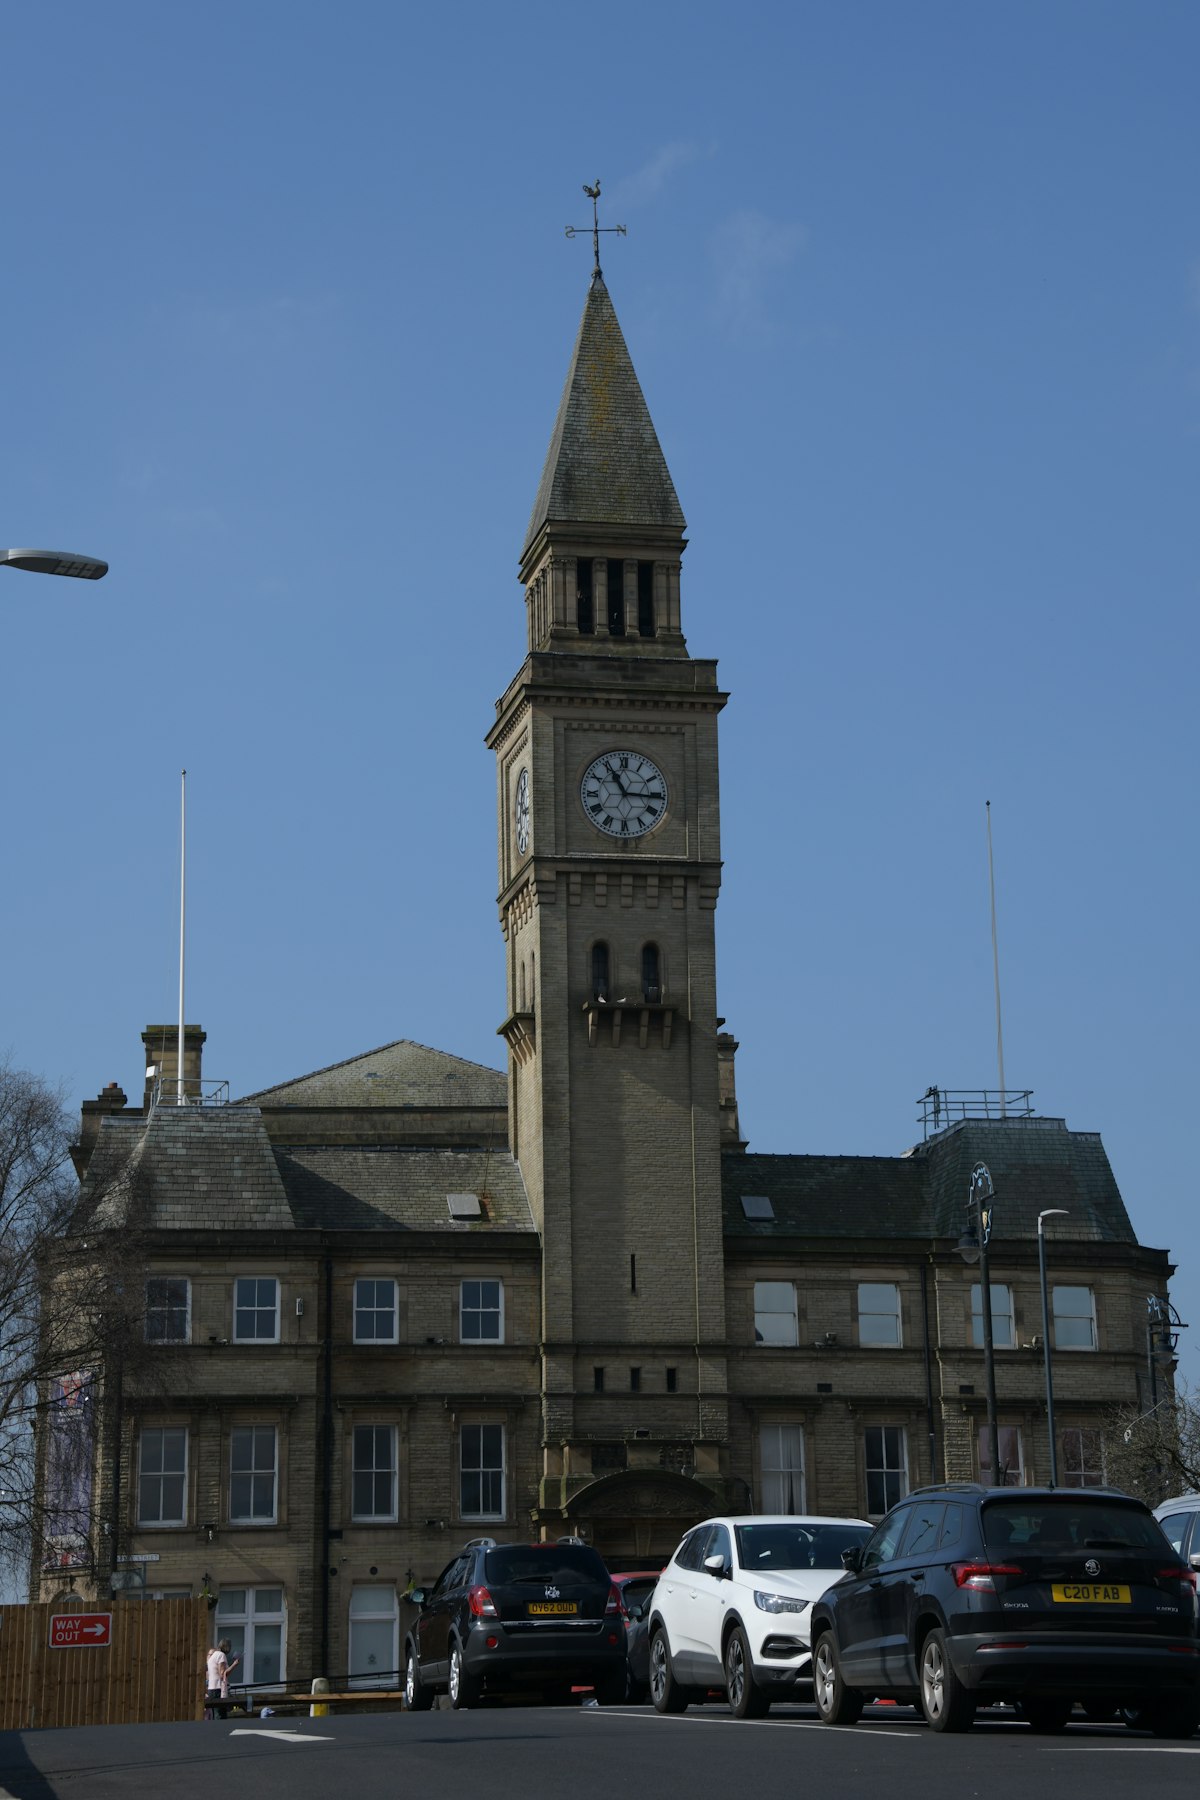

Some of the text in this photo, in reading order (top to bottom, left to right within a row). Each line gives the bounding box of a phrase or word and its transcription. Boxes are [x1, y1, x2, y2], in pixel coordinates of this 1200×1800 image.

[616, 224, 626, 237] N
[619, 757, 629, 768] XII
[636, 762, 643, 772] I
[591, 773, 603, 783] X
[646, 775, 657, 783] II
[587, 790, 598, 798] IX
[590, 803, 603, 816] VIII
[602, 815, 613, 828] VII
[621, 820, 629, 831] VI
[637, 817, 646, 828] V
[1063, 1586, 1119, 1600] C20 FAB
[56, 1620, 81, 1630] WAY
[56, 1631, 80, 1641] OUT
